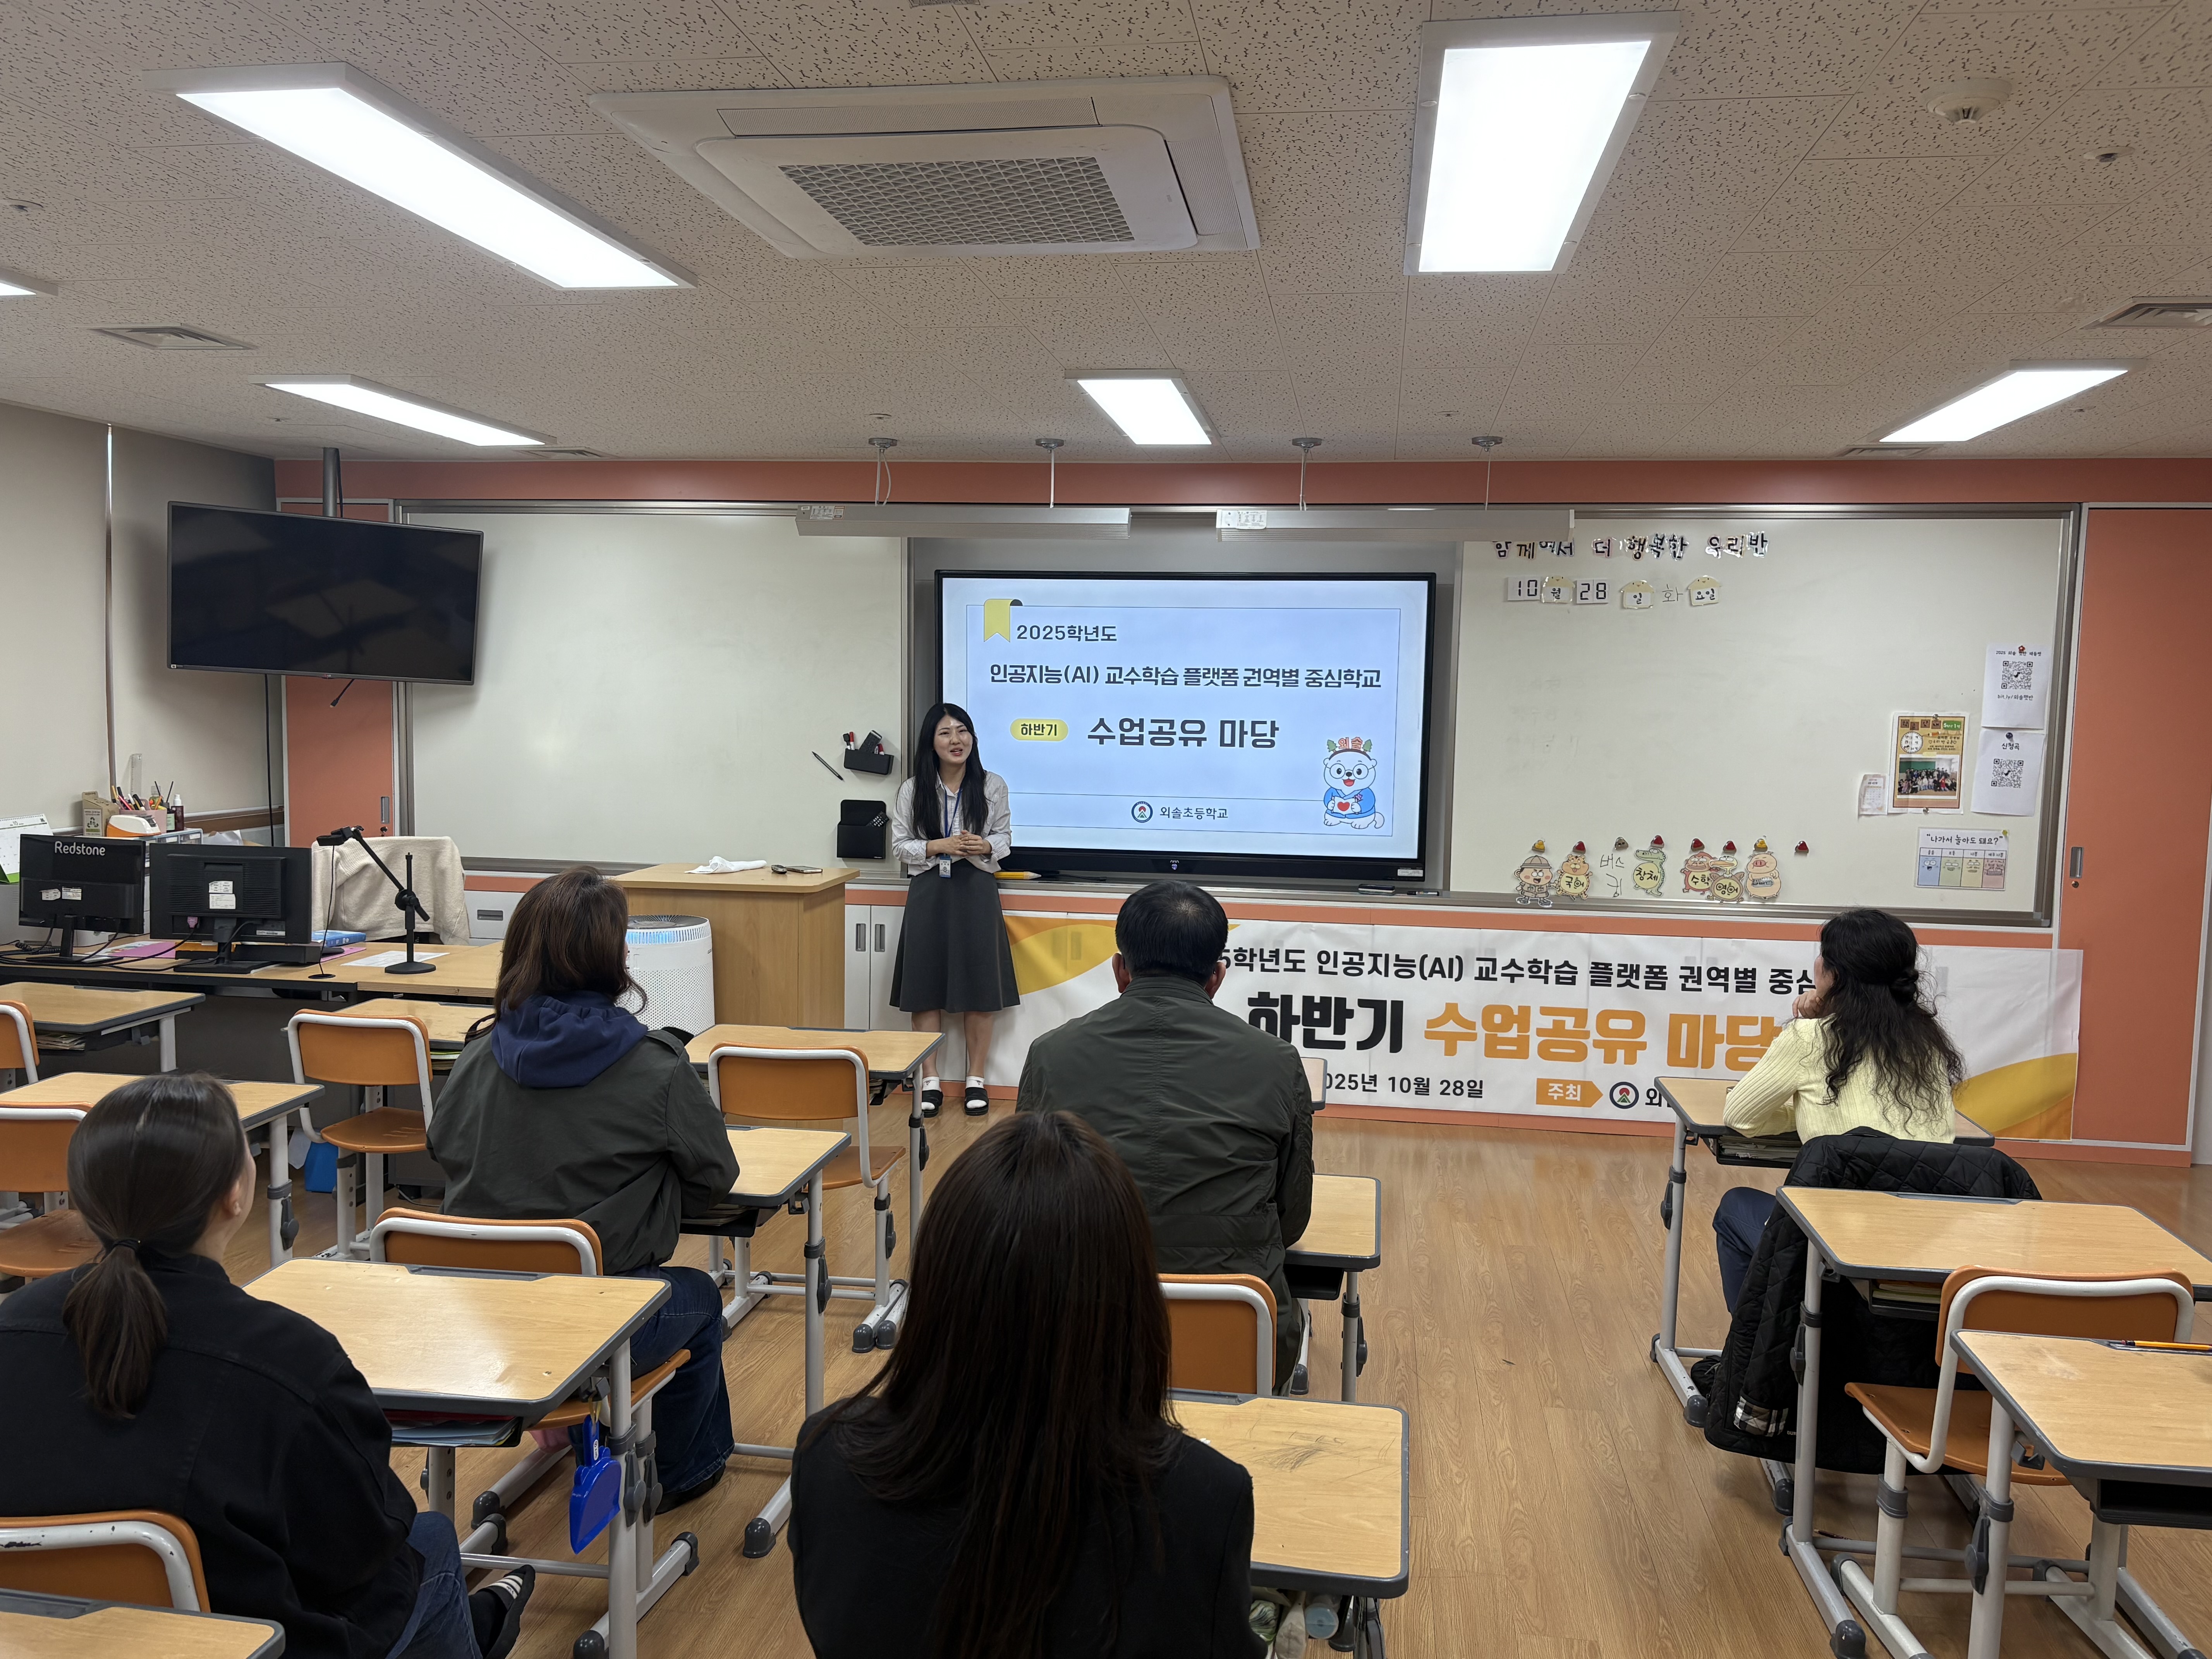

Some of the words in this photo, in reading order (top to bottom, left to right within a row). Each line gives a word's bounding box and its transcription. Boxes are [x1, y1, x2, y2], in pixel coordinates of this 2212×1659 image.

[1595, 539, 1611, 556] 더
[1628, 534, 1687, 559] 행복한
[1709, 533, 1767, 558] 우리반
[1518, 580, 1537, 596] 10
[1580, 583, 1606, 600] 28
[1662, 584, 1683, 602] 화
[1695, 589, 1715, 600] 요일
[1017, 625, 1116, 641] 2025학년도
[991, 665, 1098, 684] 인공지능(AI)
[1105, 666, 1178, 685] 교수학습
[1183, 668, 1239, 686] 플랫폼
[1243, 668, 1298, 687] 권역별
[1305, 669, 1381, 688] 중심학교
[1021, 723, 1056, 736] 하반기
[1088, 718, 1207, 747] 수업공유
[1220, 720, 1279, 748] 마당
[1338, 737, 1363, 750] 외솔
[1160, 807, 1228, 819] 외솔초등학교
[55, 841, 105, 855] Redstone
[1955, 835, 1977, 845] 놀아도
[1600, 854, 1624, 869] 버스
[1636, 867, 1658, 881] 창체
[1691, 874, 1709, 886] 수학
[1218, 947, 1306, 973] 5학년도
[1317, 951, 1463, 982] 인공지능(AI)
[1474, 957, 1578, 985] 교수학습
[1589, 962, 1668, 990] 플랫폼
[1679, 966, 1756, 993] 권역별
[1248, 991, 1404, 1053] 하반기
[1425, 1003, 1647, 1065] 수업공유
[1667, 1012, 1783, 1072] 마당
[1326, 1072, 1377, 1094] 025년
[1388, 1077, 1429, 1096] 10월
[1440, 1080, 1482, 1098] 28일
[1547, 1083, 1581, 1101] 주최
